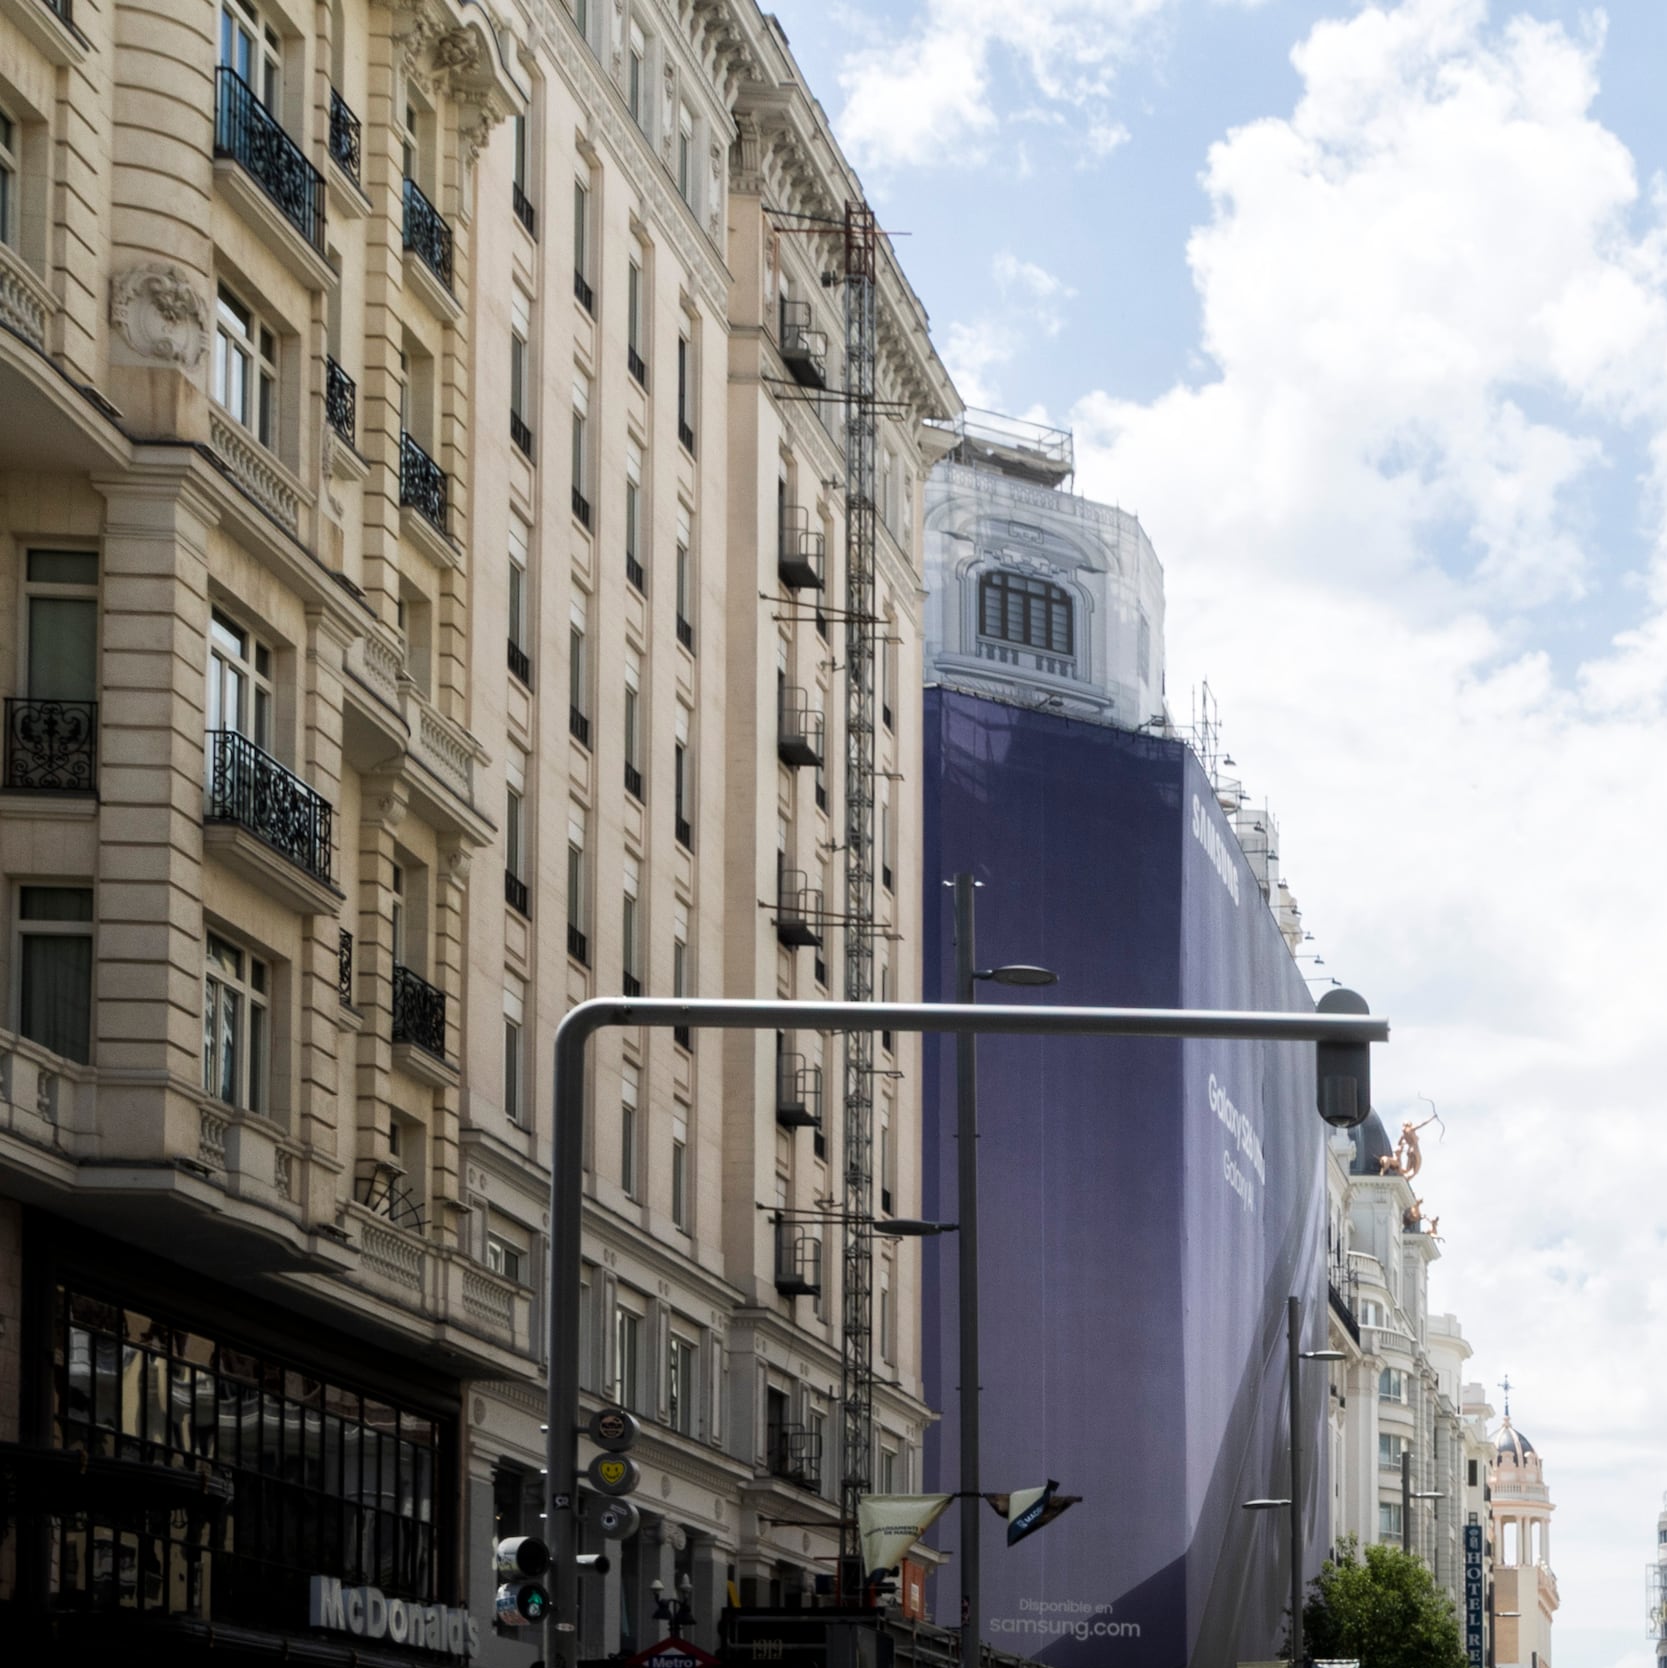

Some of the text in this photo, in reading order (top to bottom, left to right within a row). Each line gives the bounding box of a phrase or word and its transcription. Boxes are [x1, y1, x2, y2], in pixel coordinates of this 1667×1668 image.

[1192, 793, 1240, 907] SAMSUNG
[1208, 1073, 1241, 1152] Galaxy
[310, 1575, 481, 1659] McDonald's
[1019, 1598, 1113, 1615] Disponible en
[1466, 1552, 1482, 1626] HOTEL
[652, 1656, 694, 1668] Metro
[989, 1617, 1141, 1641] samsung.com
